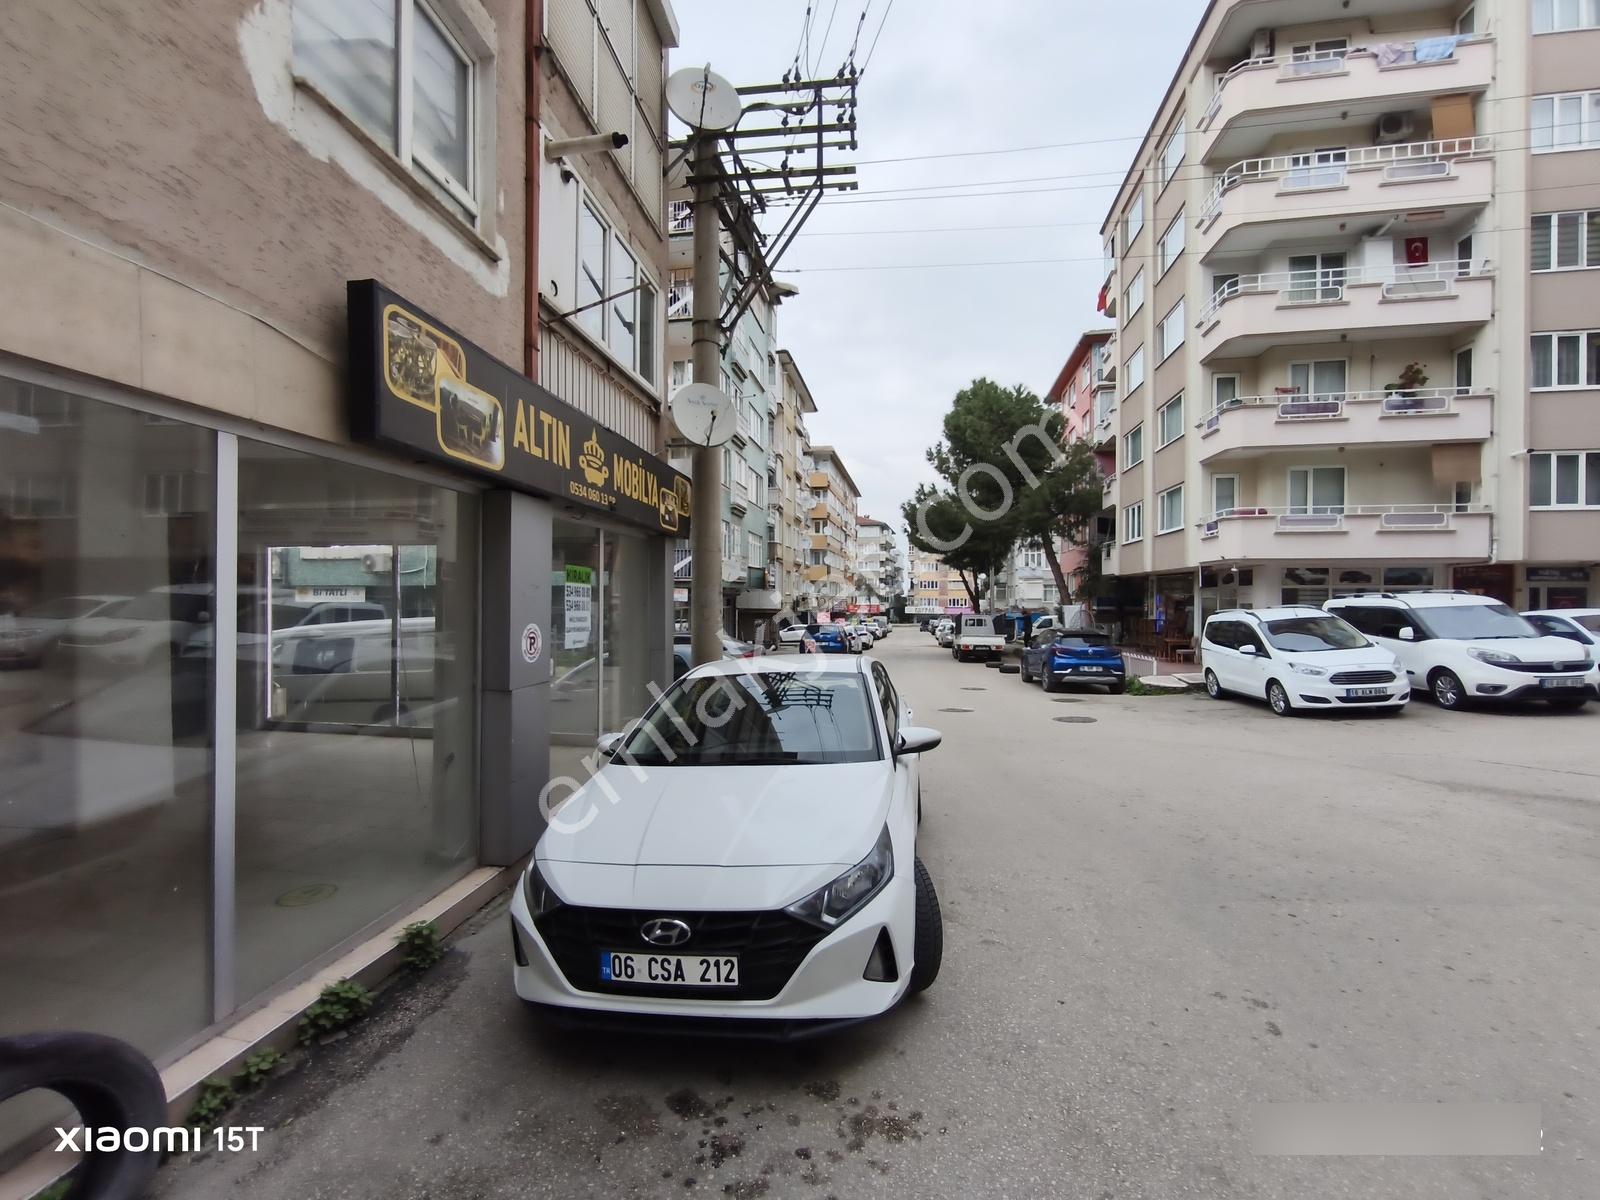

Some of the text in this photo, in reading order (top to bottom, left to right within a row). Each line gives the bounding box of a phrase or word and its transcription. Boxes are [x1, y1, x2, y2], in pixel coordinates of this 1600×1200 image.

[513, 398, 659, 509] ALTIN MOBİLYA
[570, 481, 587, 498] 0534
[611, 954, 736, 983] 06 CSA 212
